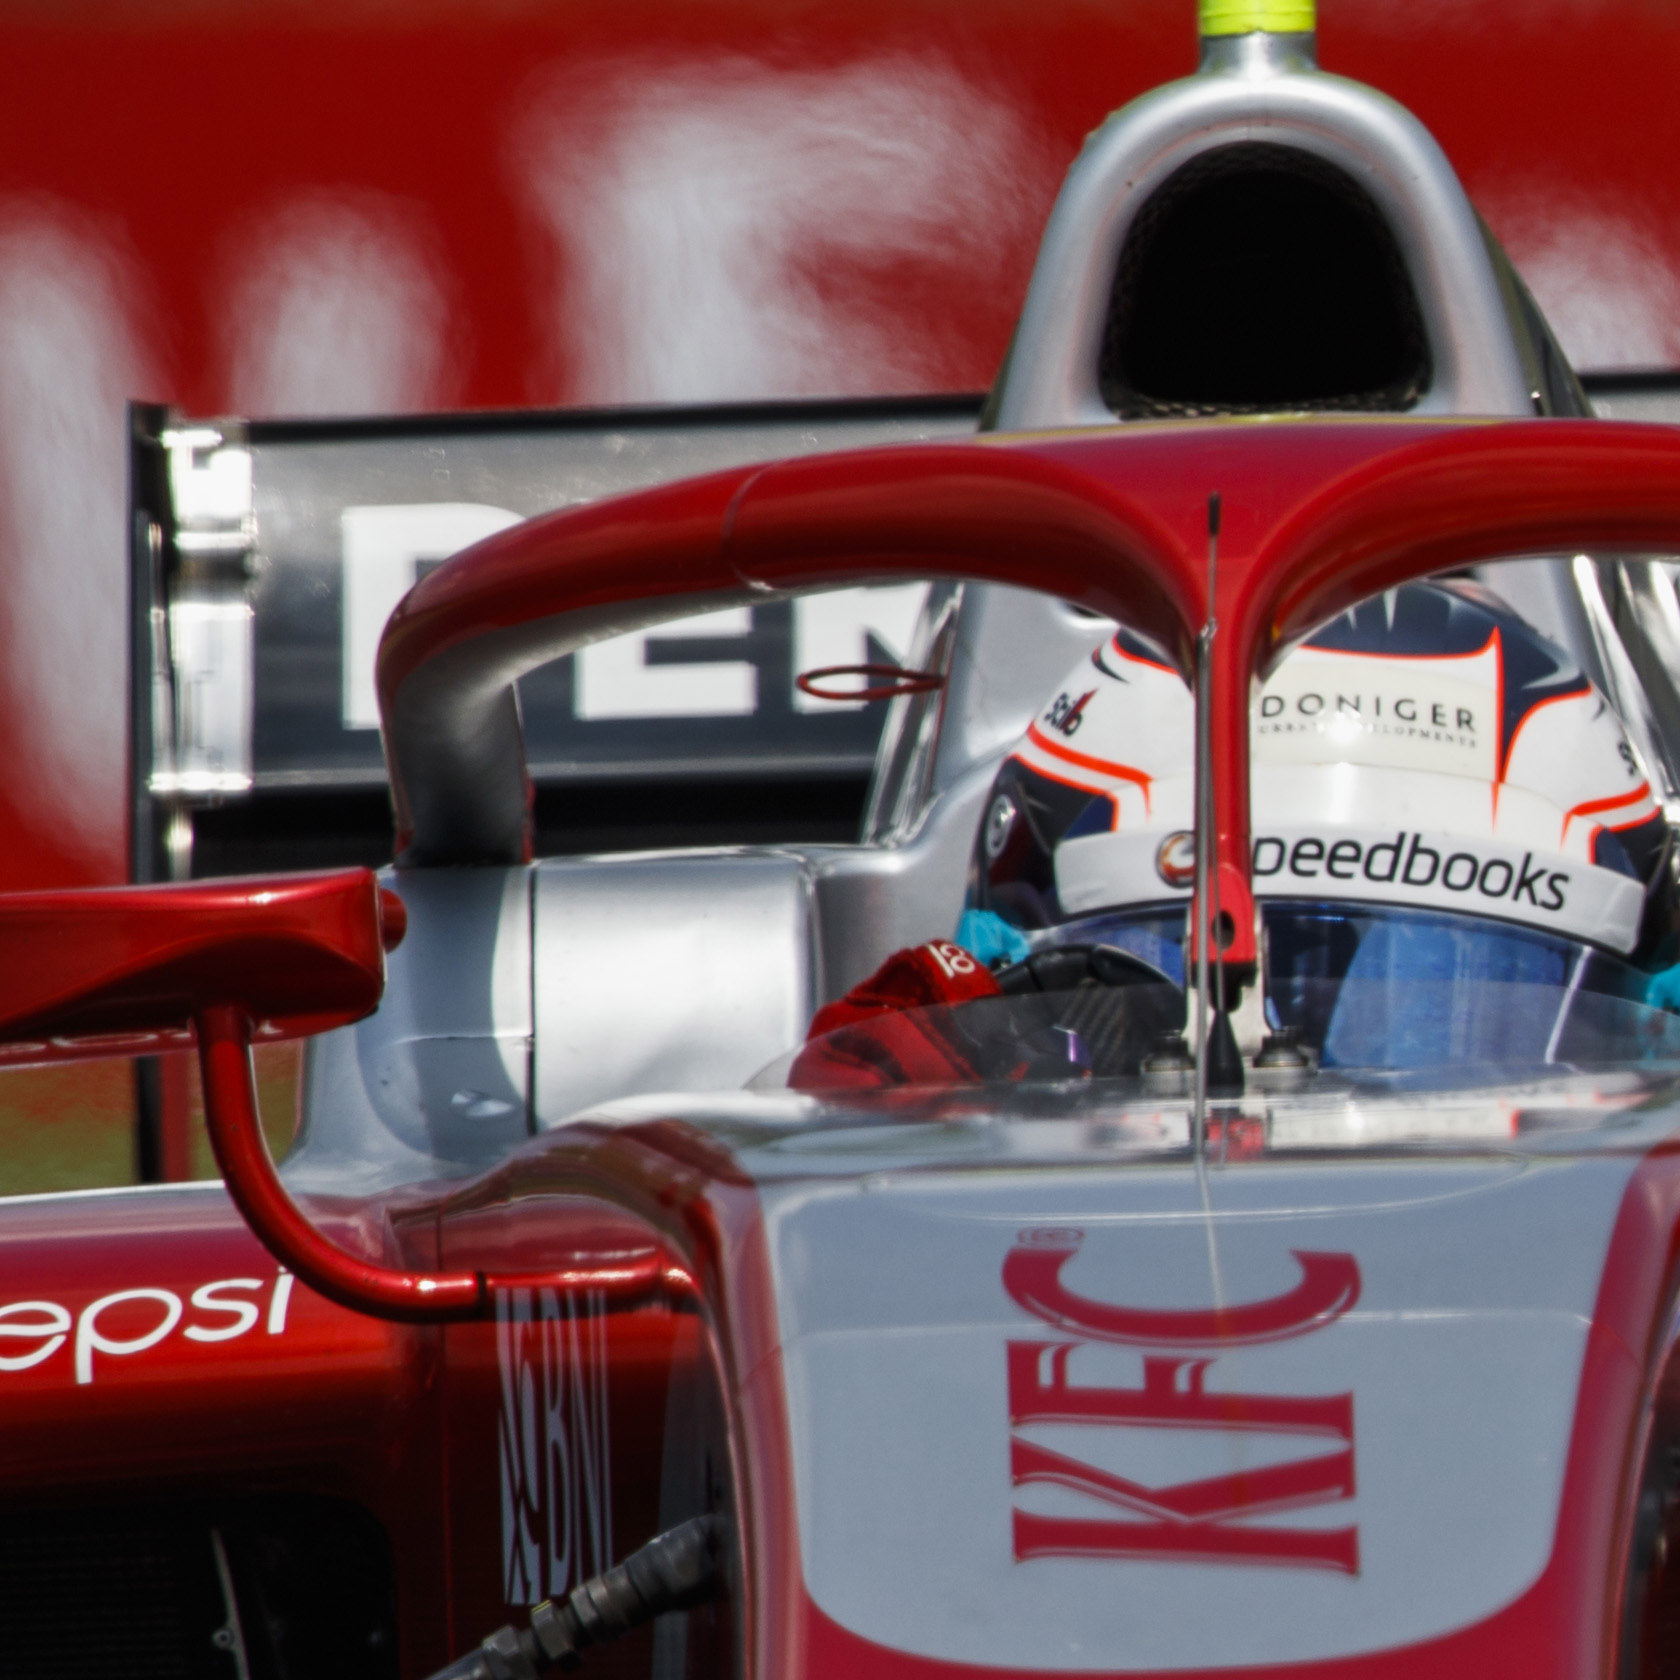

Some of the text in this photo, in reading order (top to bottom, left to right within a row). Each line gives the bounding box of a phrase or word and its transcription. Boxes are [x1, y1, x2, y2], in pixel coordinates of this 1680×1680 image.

[1260, 692, 1475, 733] DONIGER
[1252, 831, 1570, 912] peedbooks
[0, 1265, 295, 1385] epsi
[1002, 1246, 1363, 1578] KFC
